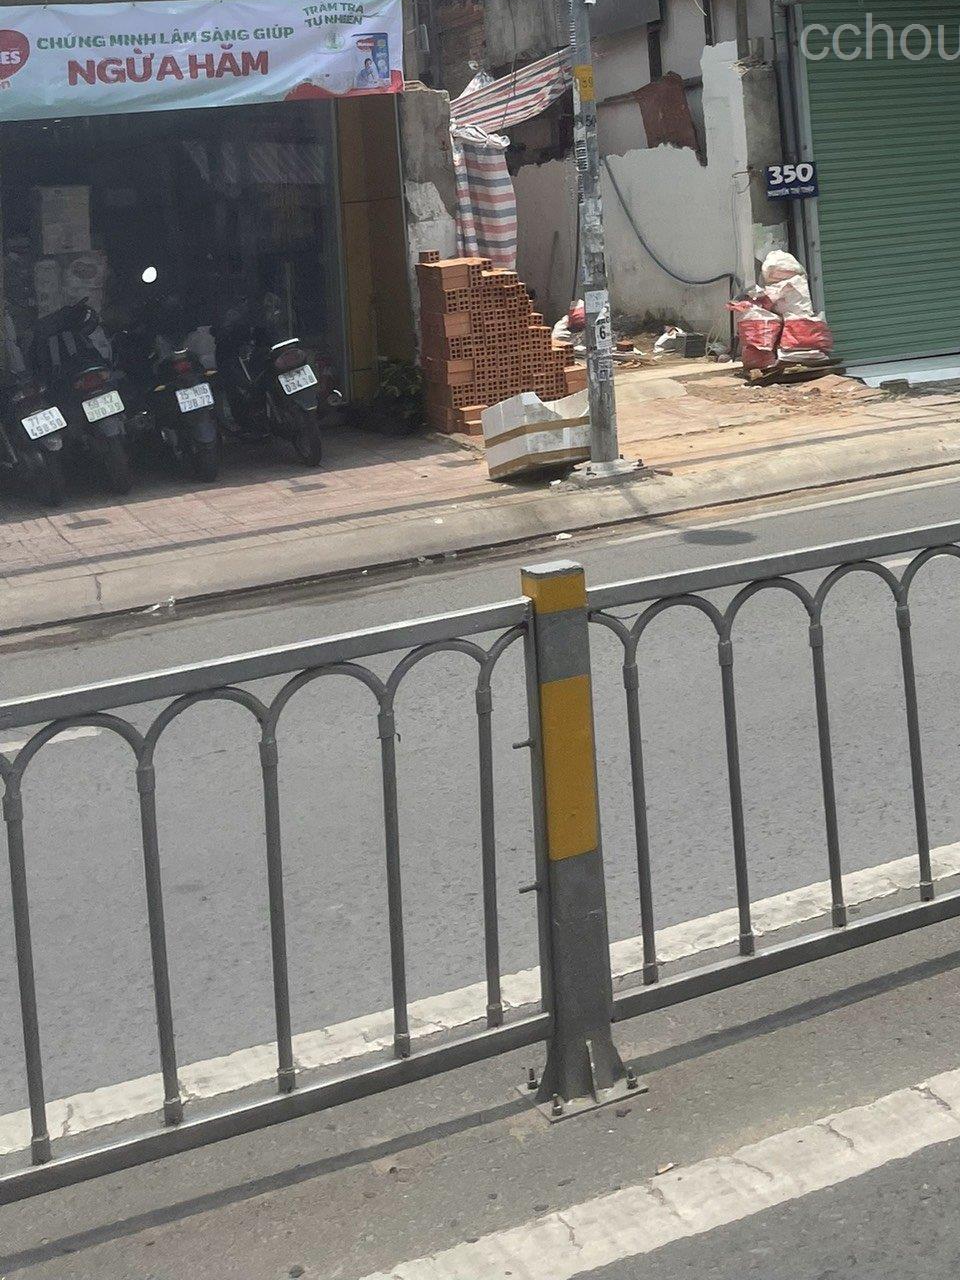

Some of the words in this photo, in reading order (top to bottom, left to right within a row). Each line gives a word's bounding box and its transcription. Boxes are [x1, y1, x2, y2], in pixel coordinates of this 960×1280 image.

[110, 32, 157, 48] MINH
[160, 28, 197, 45] LÂM
[67, 47, 184, 86] NGỪA
[188, 43, 269, 80] HĂM
[768, 163, 814, 185] 350
